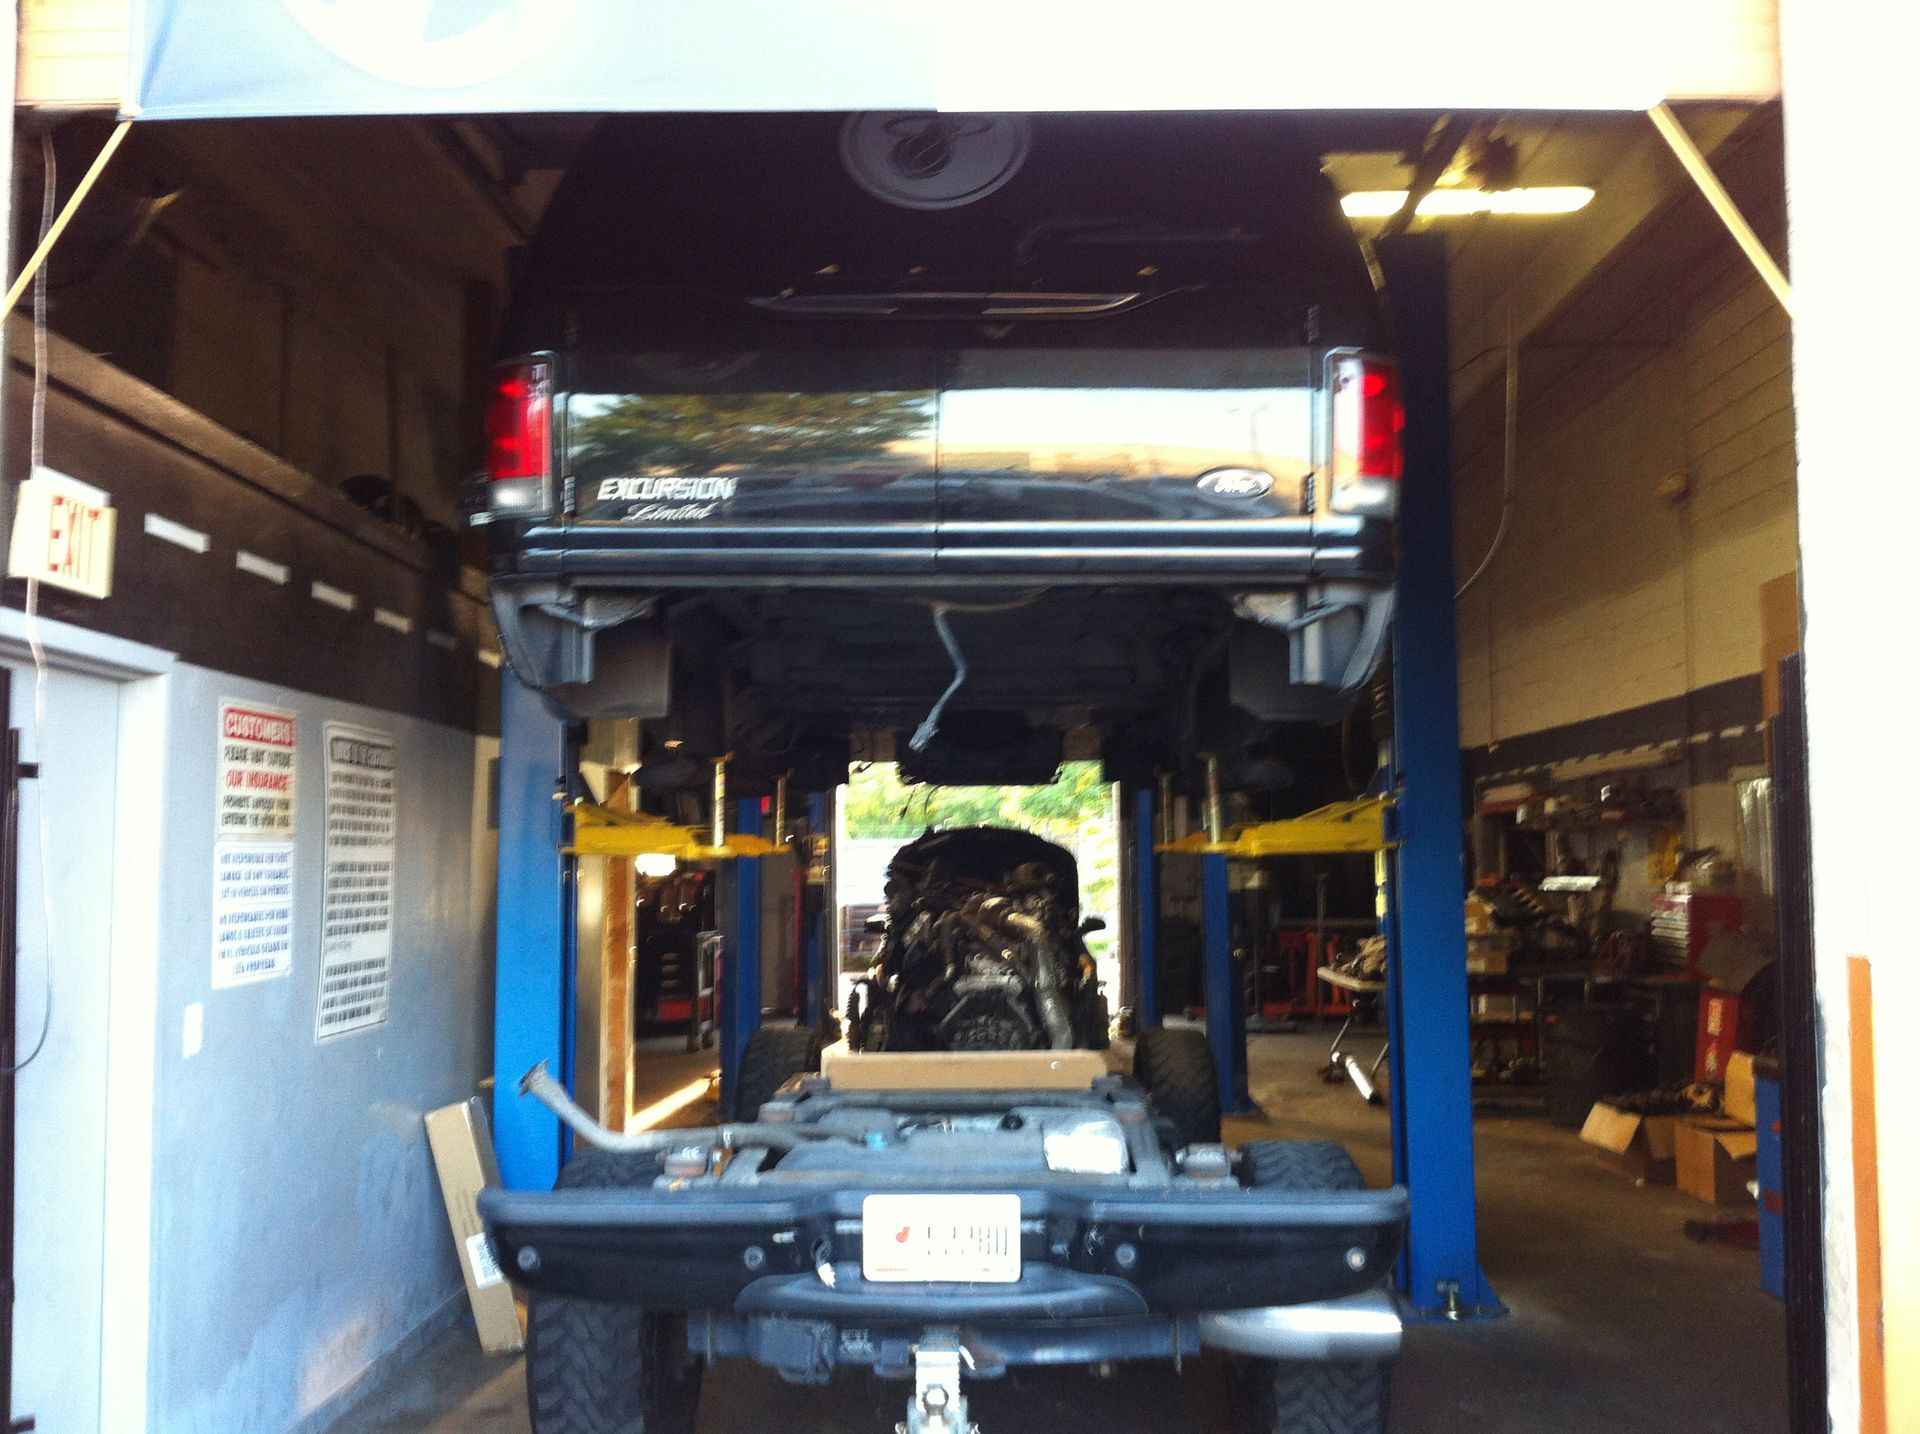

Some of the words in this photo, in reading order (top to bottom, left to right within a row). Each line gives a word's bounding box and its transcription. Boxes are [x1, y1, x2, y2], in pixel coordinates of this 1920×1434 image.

[597, 477, 738, 500] EXCURSION
[620, 502, 719, 521] Limited
[47, 494, 103, 584] EXIT
